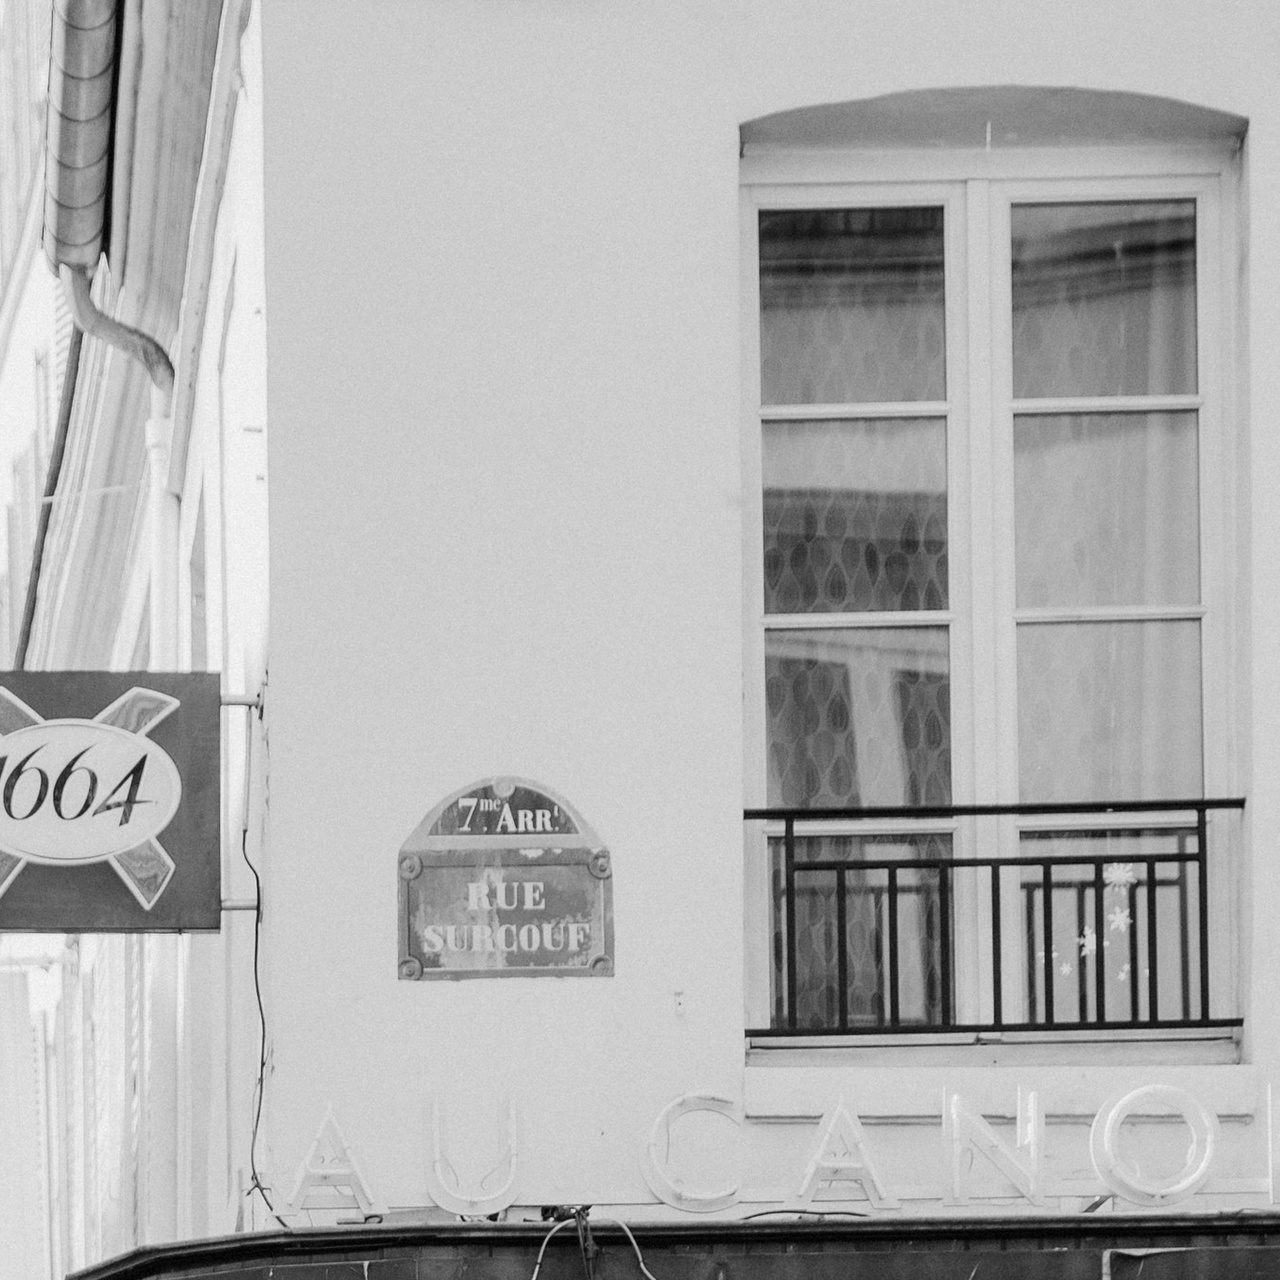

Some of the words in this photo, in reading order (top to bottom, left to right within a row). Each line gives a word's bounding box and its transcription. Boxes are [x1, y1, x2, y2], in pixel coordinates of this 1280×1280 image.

[467, 881, 546, 910] RUE
[422, 922, 592, 953] SURCOUF
[273, 1092, 520, 1216] AU
[639, 1083, 1280, 1214] CANO
